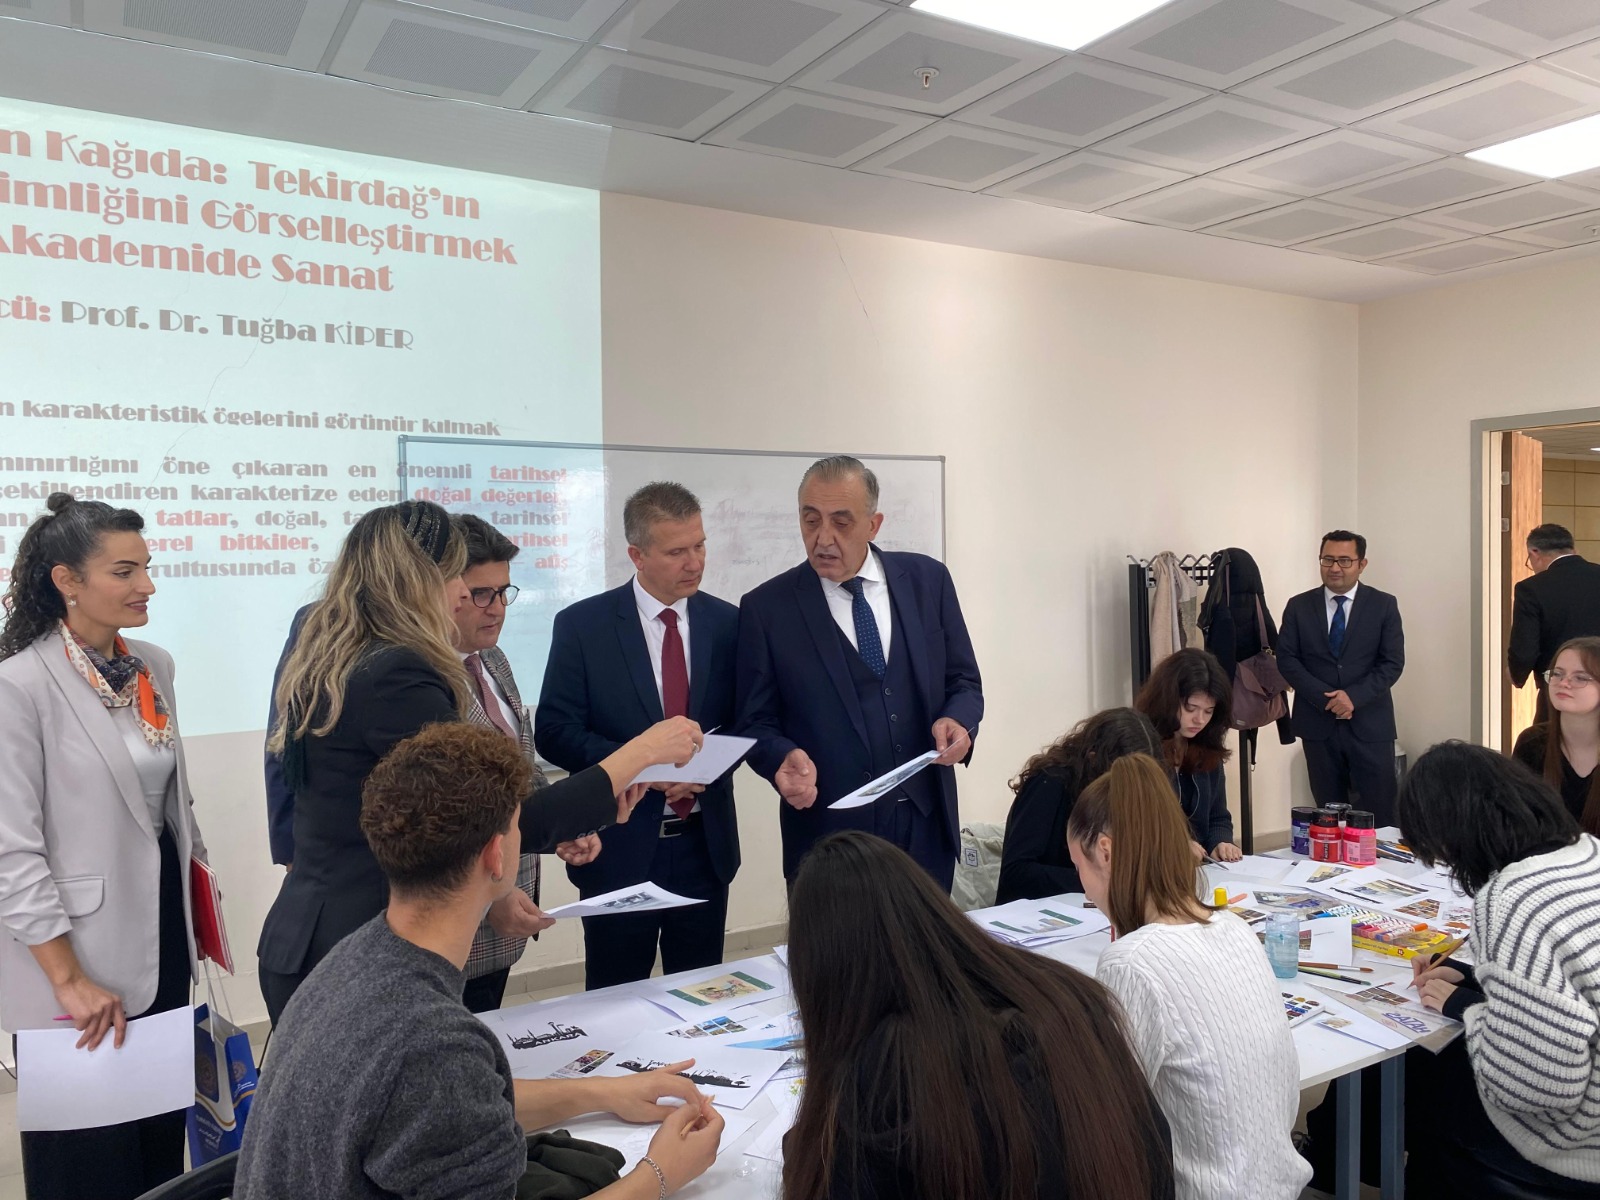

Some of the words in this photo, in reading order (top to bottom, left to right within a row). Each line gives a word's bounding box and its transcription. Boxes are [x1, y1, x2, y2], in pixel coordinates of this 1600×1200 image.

[46, 130, 228, 184] Kağıda:
[201, 199, 518, 266] Görselleştirmek
[271, 253, 394, 292] Sanat
[61, 301, 150, 330] Prof.
[159, 309, 209, 335] Dr.
[216, 314, 317, 344] Tuğba
[324, 321, 414, 350] KİPER
[23, 400, 208, 424] karakteristik
[325, 412, 418, 432] görünür
[422, 419, 501, 436] kılmak
[162, 456, 210, 474] öne
[232, 460, 328, 479] çıkaran
[348, 464, 377, 478] en
[396, 461, 472, 479] önemli
[490, 465, 567, 481] tarihsel
[0, 481, 178, 500] ekillendiren
[191, 484, 338, 501] karakterize
[348, 487, 404, 502] eden
[414, 487, 471, 505] doğal
[156, 510, 238, 529] tatlar,
[255, 510, 327, 530] doğal,
[491, 511, 567, 526] tarihsel
[220, 533, 319, 553] bitkiler,
